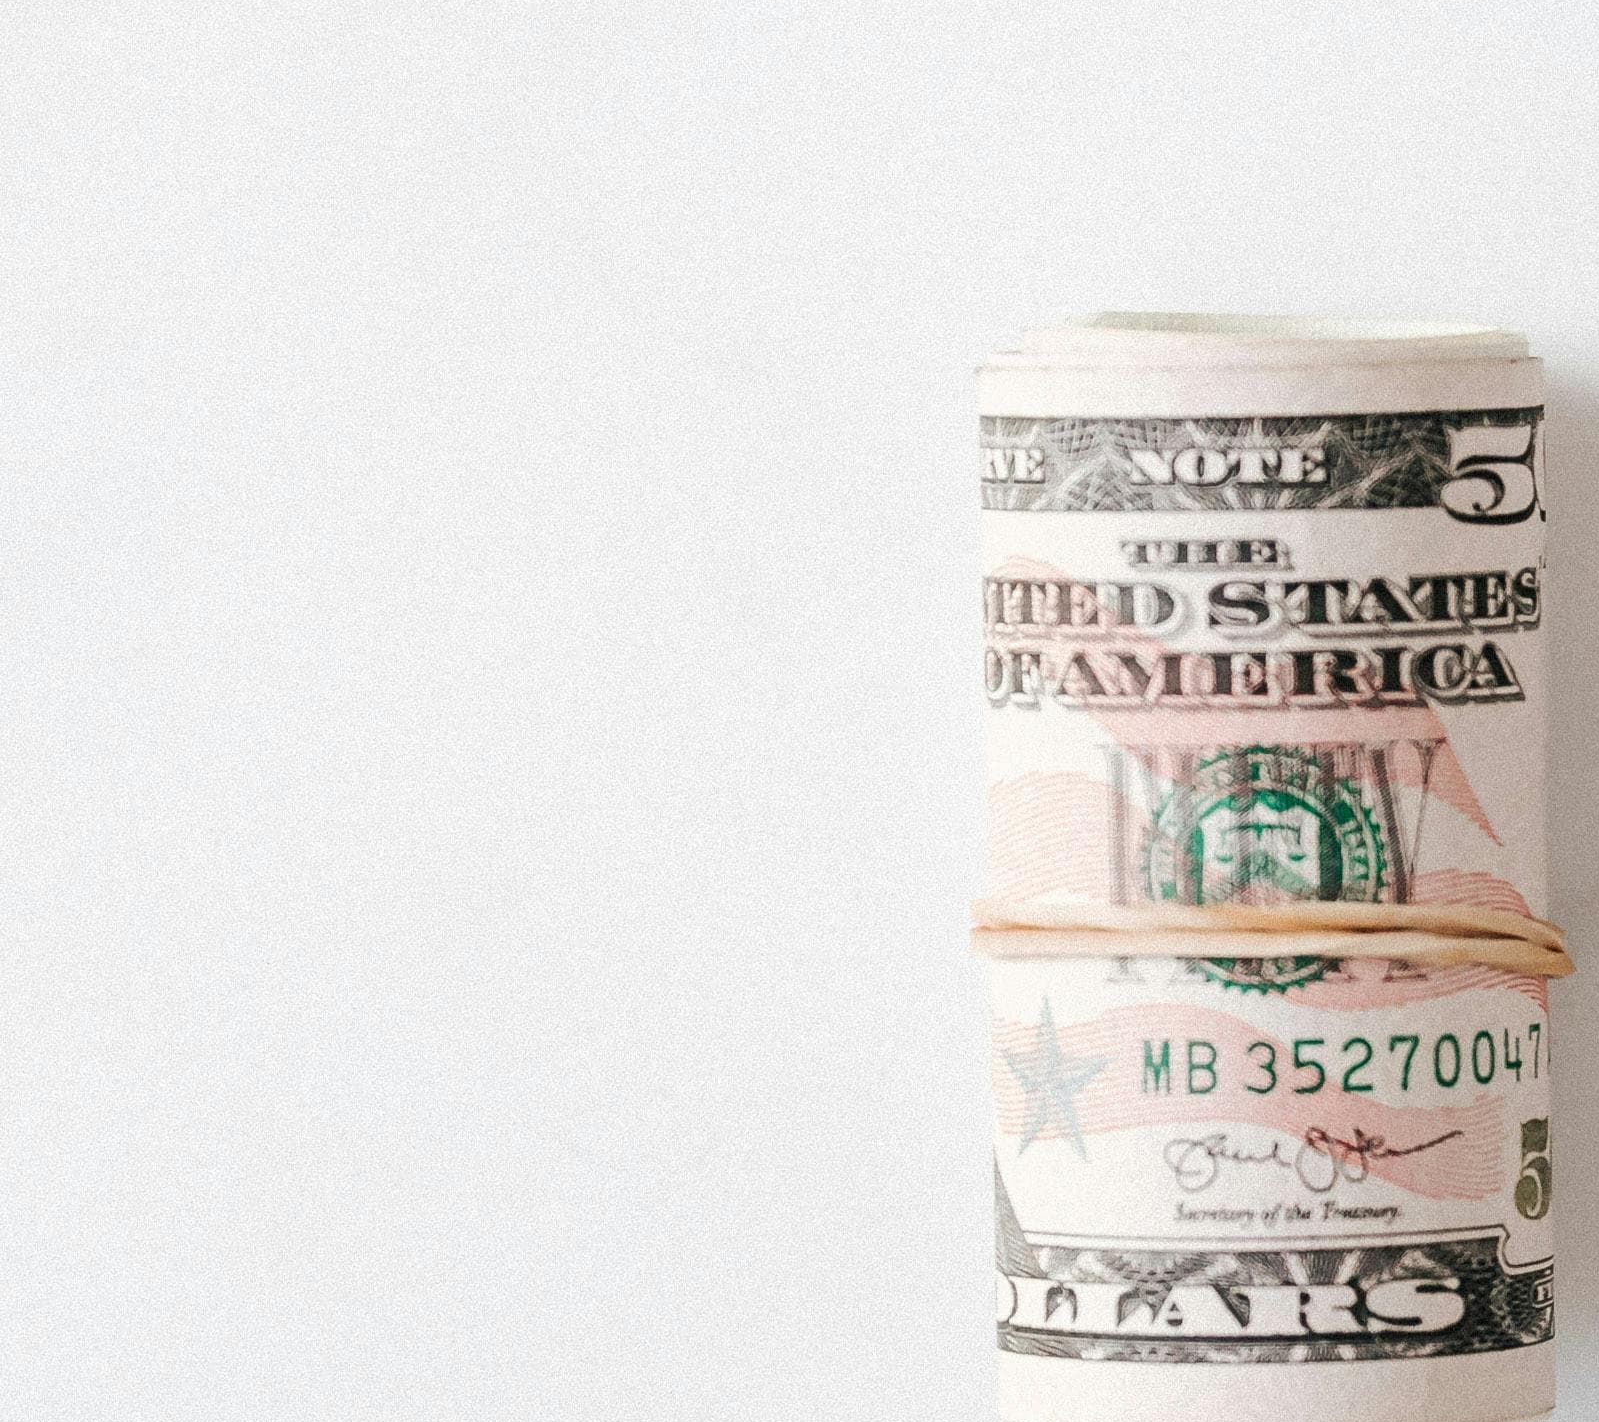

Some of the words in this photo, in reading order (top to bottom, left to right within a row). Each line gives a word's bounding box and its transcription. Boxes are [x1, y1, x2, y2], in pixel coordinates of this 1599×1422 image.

[1124, 446, 1329, 487] NOTE
[1121, 538, 1292, 571] THE
[1207, 565, 1541, 637] STATES
[1056, 642, 1527, 708] AMERICA
[1142, 1038, 1218, 1096] MB
[1246, 1022, 1543, 1096] 35270047
